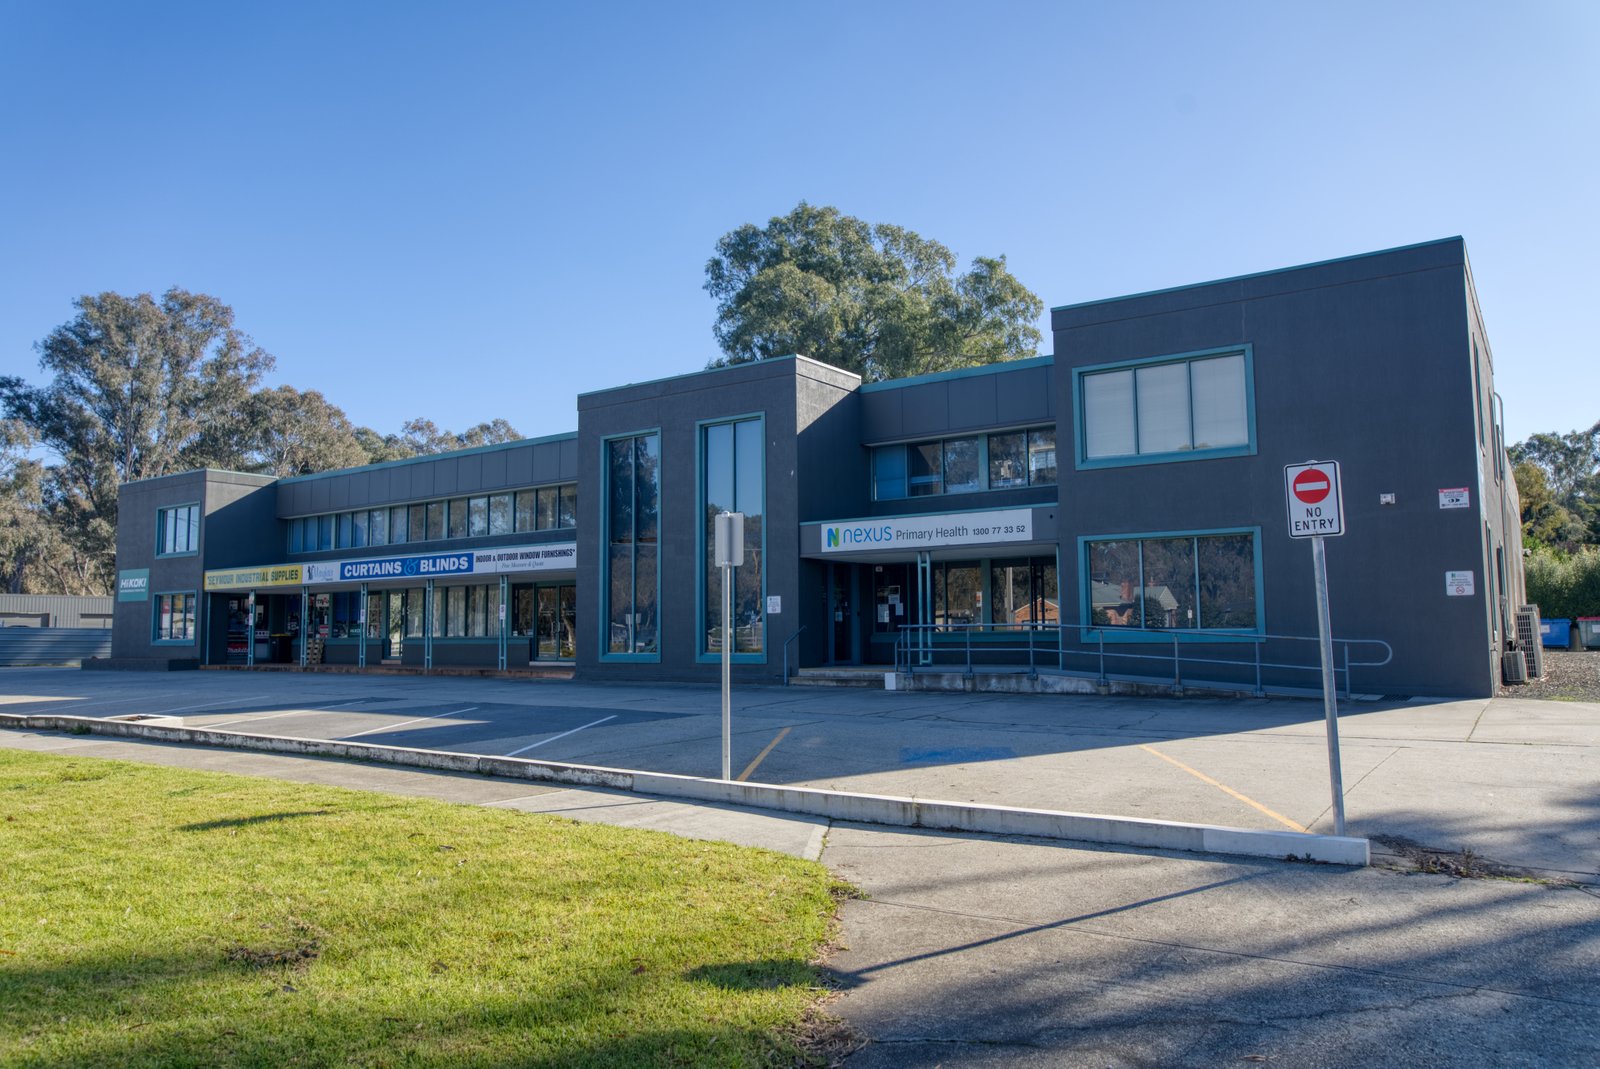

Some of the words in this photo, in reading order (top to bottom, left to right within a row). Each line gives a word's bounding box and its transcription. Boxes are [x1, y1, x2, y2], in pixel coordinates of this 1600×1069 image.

[1306, 507, 1322, 518] NO
[1294, 518, 1334, 531] ENTRY
[843, 526, 893, 544] nexus
[896, 528, 934, 541] Primary
[935, 525, 968, 538] Health
[972, 527, 990, 536] 1300
[992, 526, 1001, 535] 77
[1003, 525, 1014, 534] 33
[1015, 525, 1026, 534] 52
[475, 554, 492, 563] INDOOR
[496, 552, 519, 562] OUTDOOR
[519, 550, 541, 560] WINDOW
[344, 561, 402, 577] CURTAINS
[404, 558, 418, 576] &
[420, 556, 469, 573] BLINDS
[235, 571, 269, 584] INDUSTRIAL
[271, 569, 299, 582] SUPPLIES
